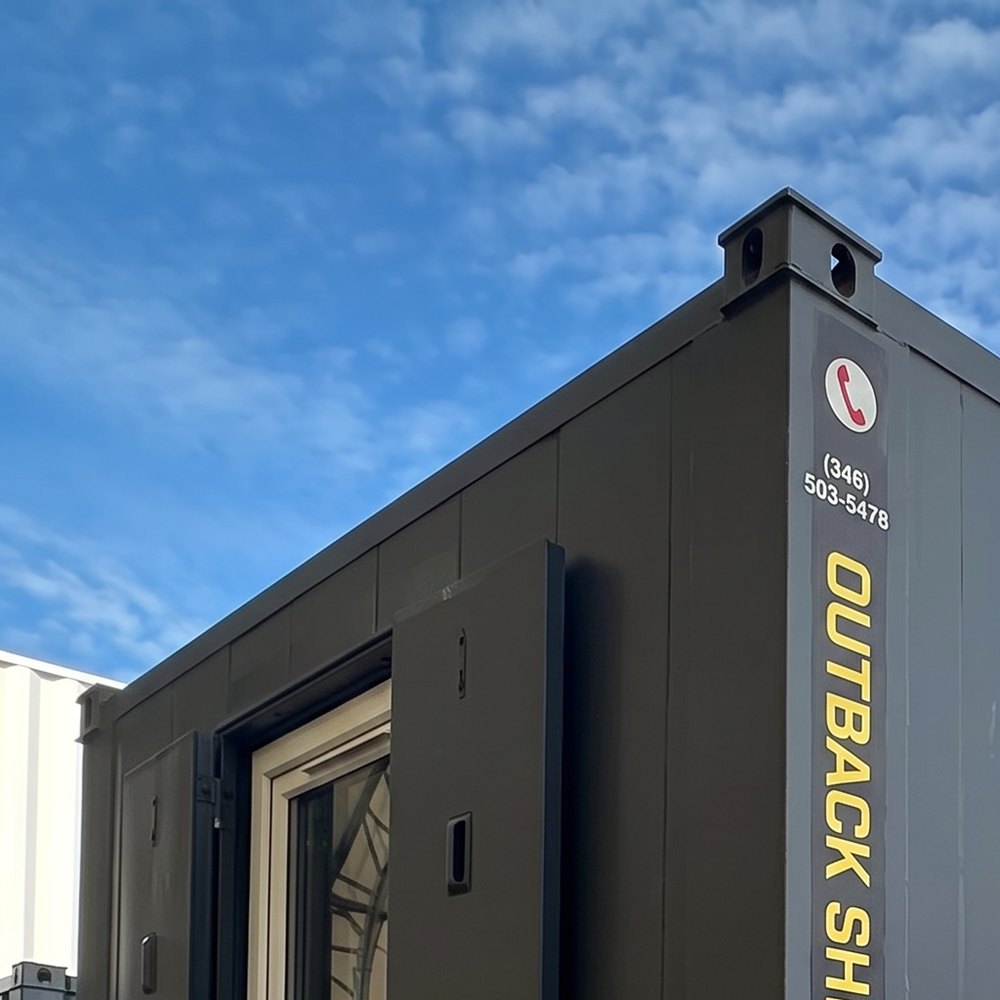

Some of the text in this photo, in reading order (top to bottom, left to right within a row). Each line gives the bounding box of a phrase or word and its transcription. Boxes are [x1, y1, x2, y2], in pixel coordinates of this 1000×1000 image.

[803, 472, 890, 531] 503-5478
[823, 453, 871, 498] (346)
[826, 550, 872, 888] OUTBACK
